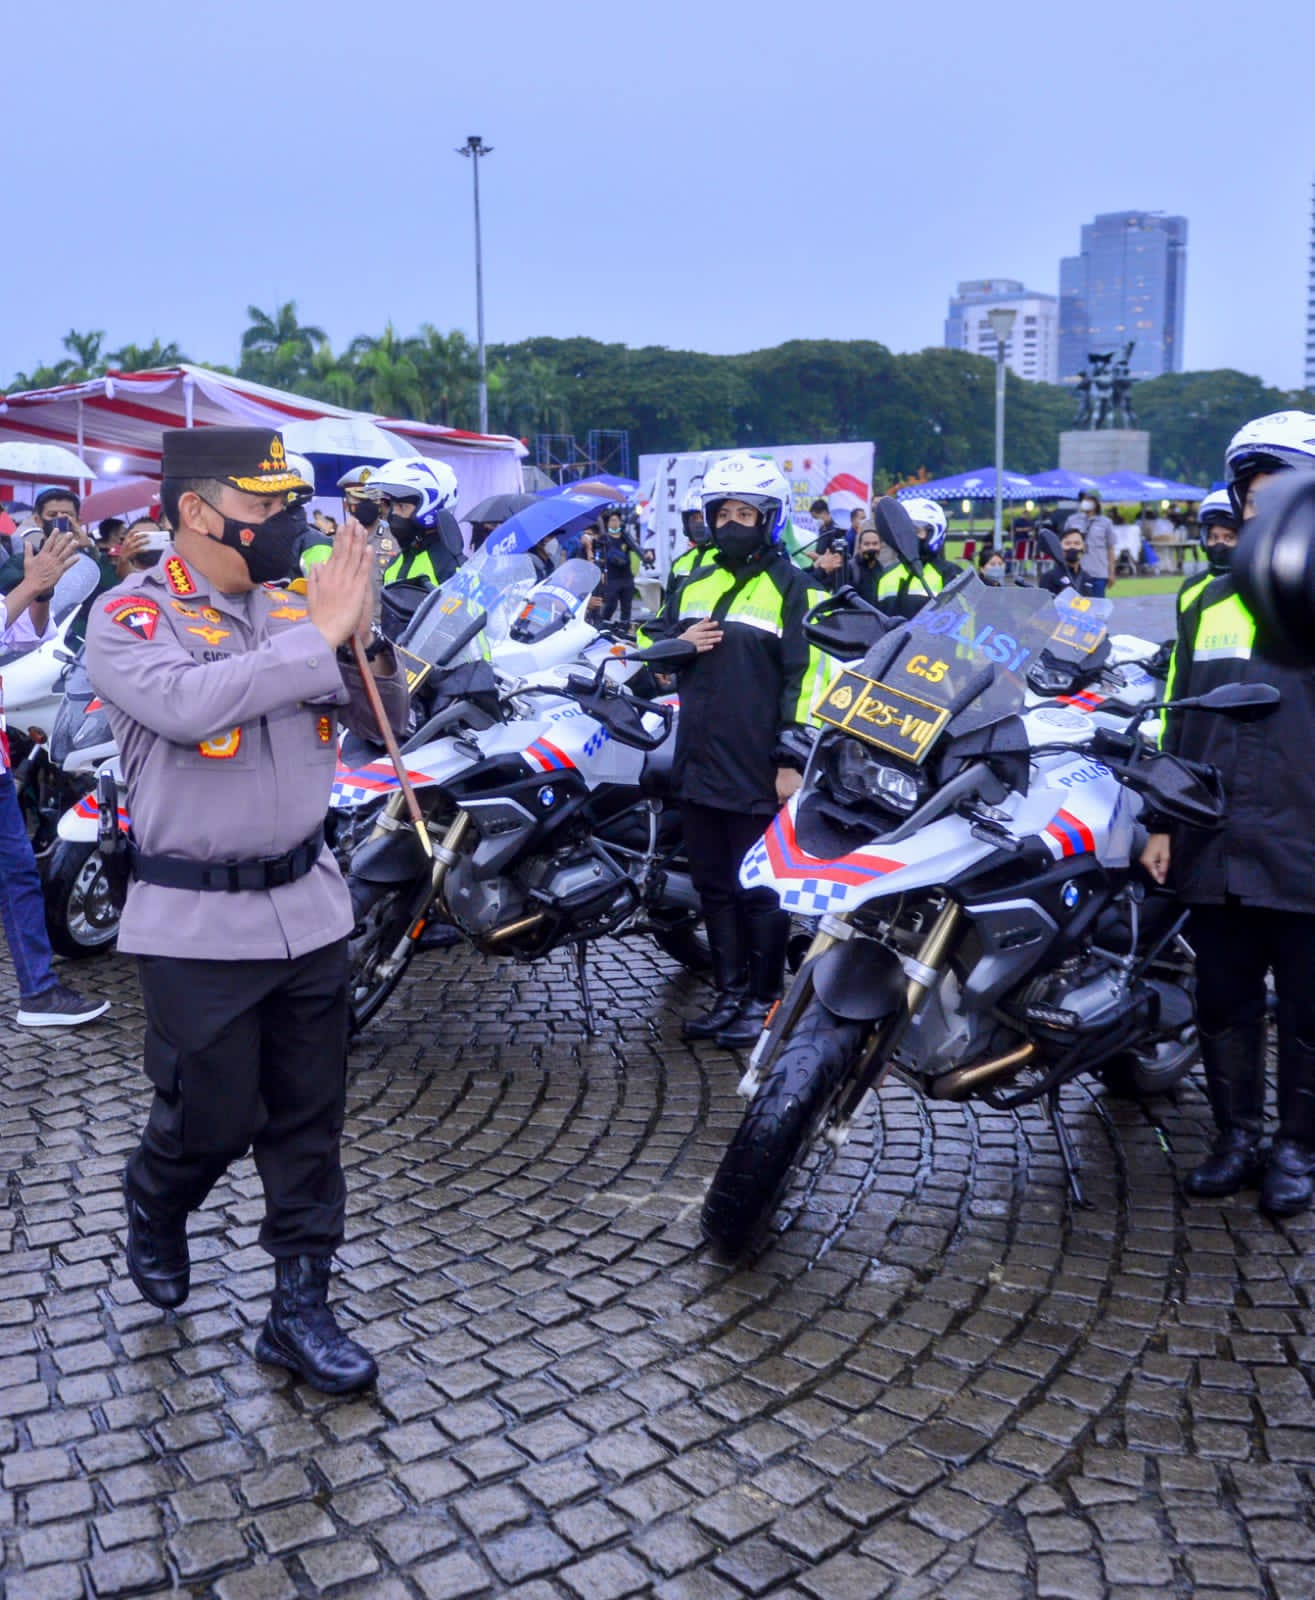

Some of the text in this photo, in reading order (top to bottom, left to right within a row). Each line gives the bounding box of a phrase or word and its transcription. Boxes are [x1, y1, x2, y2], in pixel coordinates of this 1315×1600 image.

[904, 608, 1031, 673] POLISI
[906, 654, 949, 683] C.5
[1058, 762, 1112, 788] POLIS
